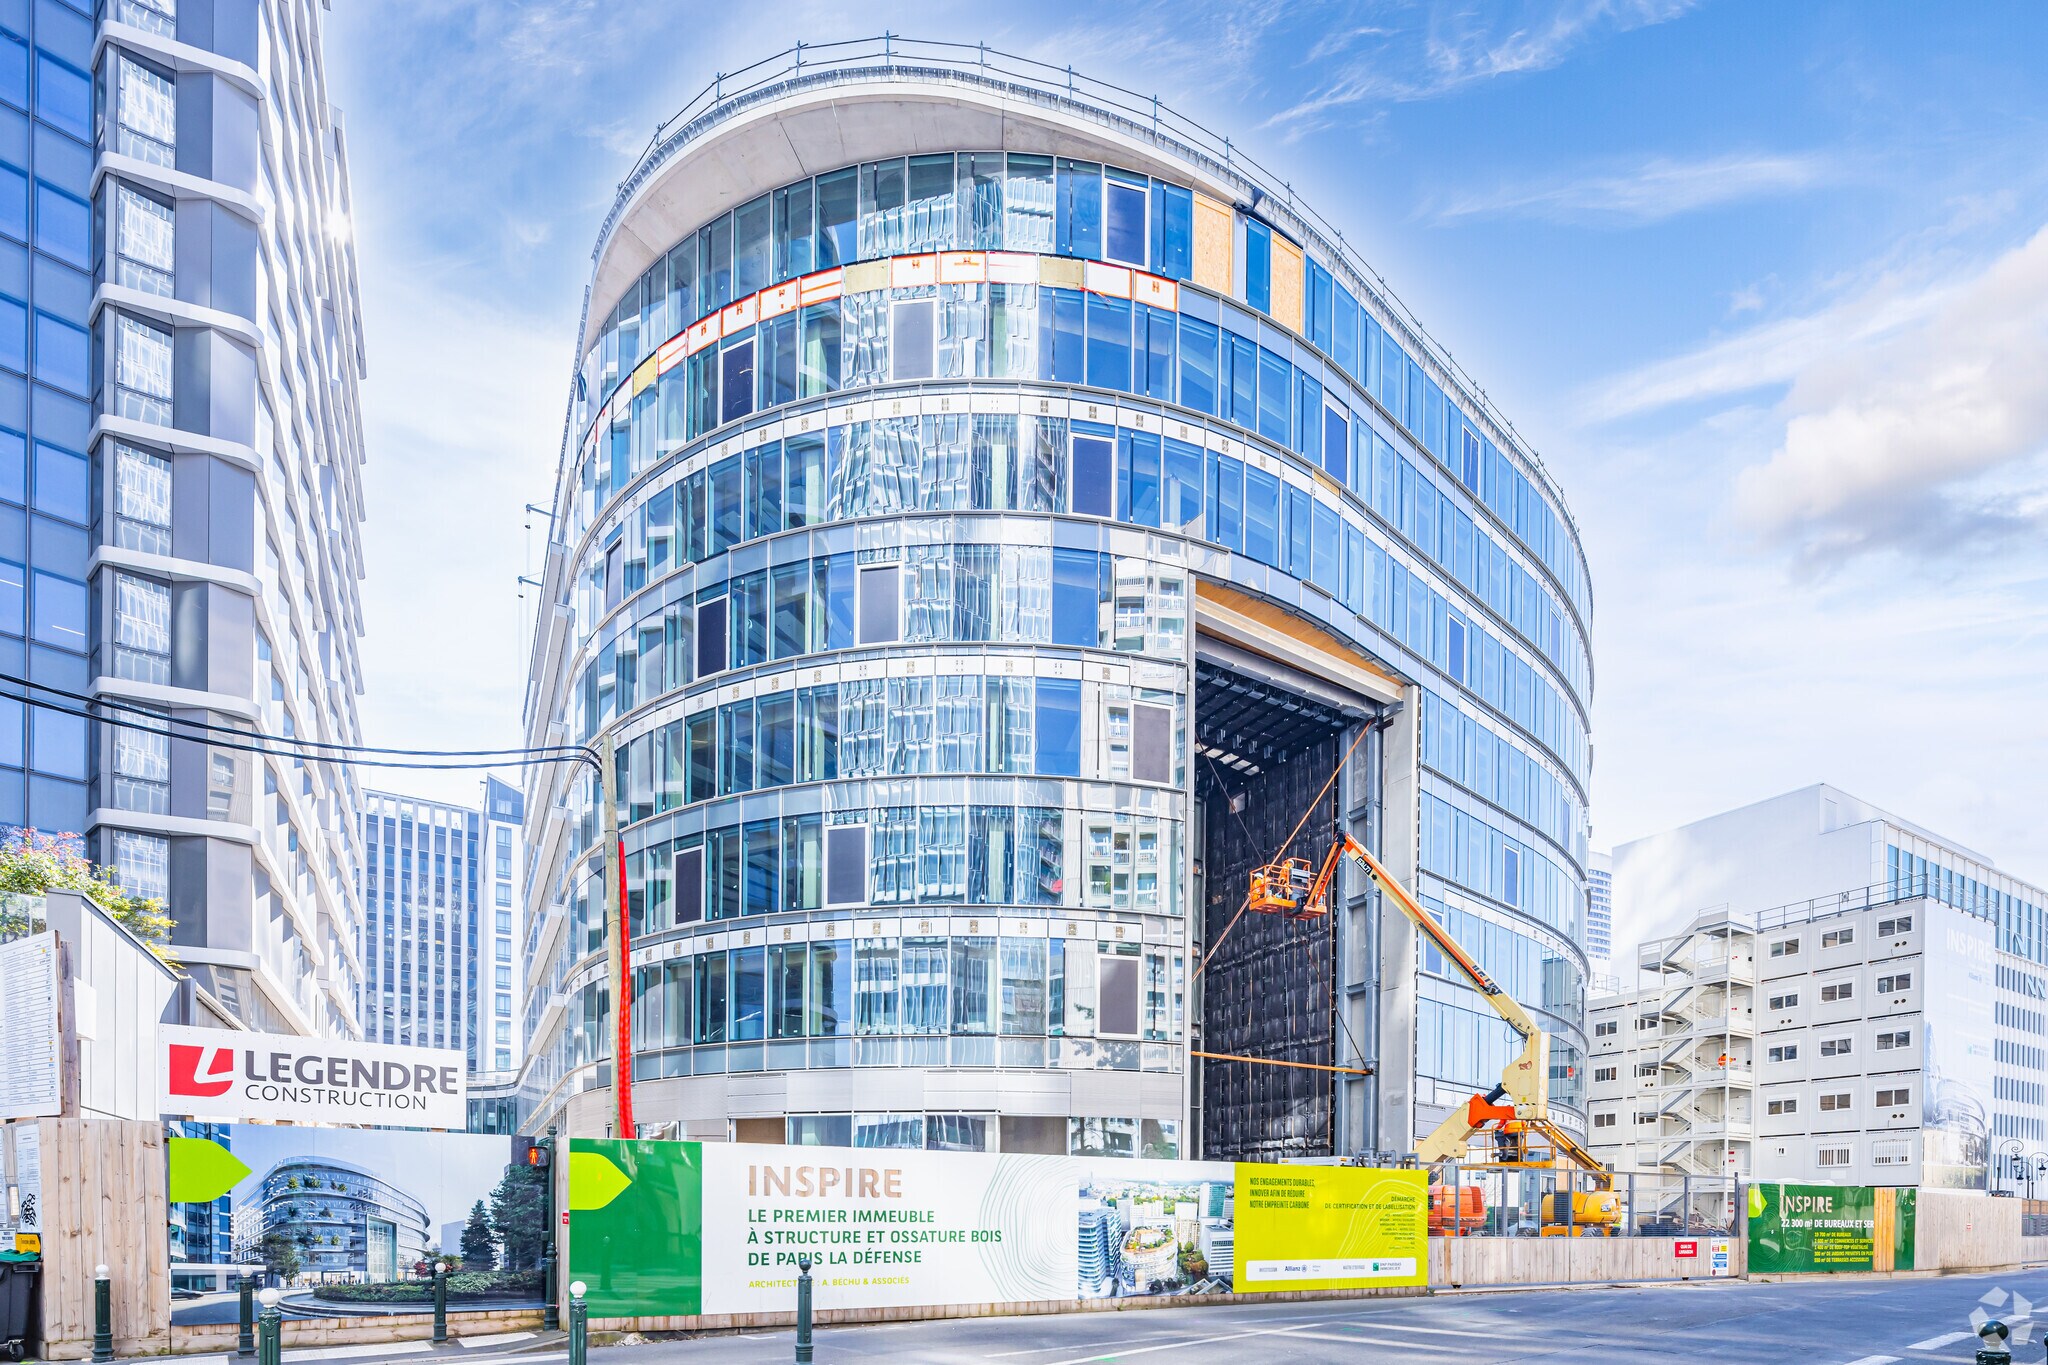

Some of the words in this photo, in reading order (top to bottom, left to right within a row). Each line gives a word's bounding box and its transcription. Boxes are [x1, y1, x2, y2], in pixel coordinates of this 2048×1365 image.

[1947, 928, 1991, 962] INSPIRE
[245, 1049, 458, 1095] LEGENDRE
[245, 1084, 427, 1110] CONSTRUCTION
[748, 1165, 903, 1198] INSPIRE
[1250, 1177, 1259, 1185] NOS
[1260, 1178, 1292, 1186] ENGAGEMENTS
[1250, 1189, 1269, 1197] INNOVER
[1270, 1189, 1280, 1197] AFIN
[1281, 1189, 1286, 1197] DE
[1250, 1200, 1263, 1208] NOTRE
[1264, 1200, 1289, 1208] EMPREINTE
[1289, 1200, 1310, 1209] CARBONE
[1780, 1195, 1833, 1214] INSPIRE
[748, 1209, 767, 1223] LE
[773, 1209, 847, 1223] PREMIER
[853, 1210, 935, 1223] IMMEUBLE
[1781, 1219, 1789, 1228] 22
[1791, 1219, 1803, 1228] 300
[1814, 1219, 1823, 1228] DE
[1824, 1219, 1854, 1228] BUREAUX
[1855, 1220, 1863, 1228] ET
[747, 1227, 759, 1244] À
[764, 1230, 861, 1244] STRUCTURE
[867, 1230, 885, 1243] ET
[890, 1230, 966, 1243] OSSATURE
[971, 1230, 1002, 1243] BOIS
[748, 1252, 770, 1266] DE
[829, 1251, 847, 1265] LA
[853, 1248, 922, 1264] DÉFENSE
[748, 1280, 815, 1288] ARCHITECTE
